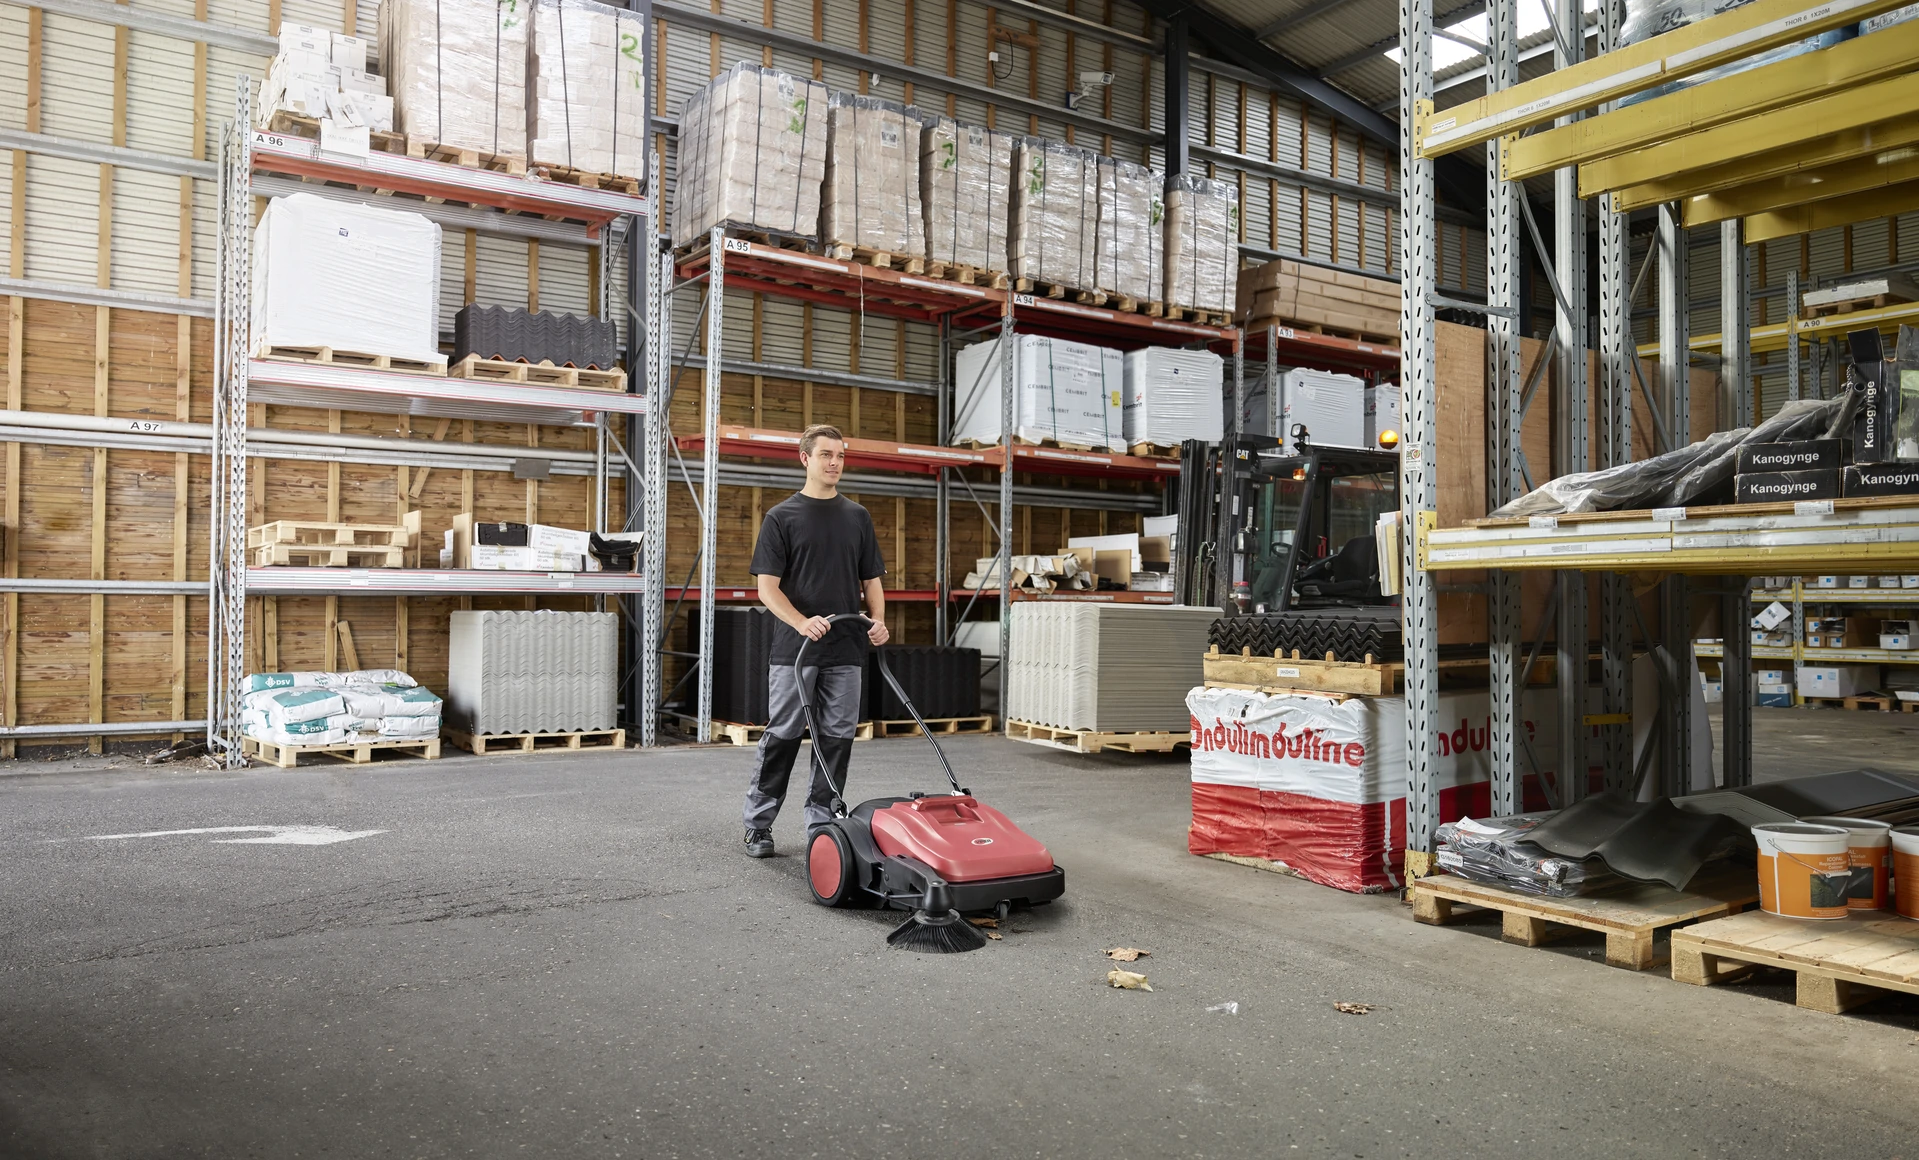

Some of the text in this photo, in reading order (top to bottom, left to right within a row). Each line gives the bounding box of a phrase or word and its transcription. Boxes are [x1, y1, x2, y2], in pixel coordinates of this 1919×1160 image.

[1785, 17, 1802, 26] THOR
[1811, 7, 1831, 18] 1X20M
[621, 33, 642, 63] 2
[256, 134, 283, 146] A 96
[727, 240, 748, 251] A 95
[1016, 295, 1033, 304] A 94
[1811, 319, 1820, 327] 90
[1280, 328, 1284, 336] A
[1066, 347, 1088, 355] CEMBRIT
[1065, 389, 1088, 397] CEMBRIT
[1864, 381, 1877, 448] Kanogynge
[130, 421, 159, 431] A 97
[1236, 449, 1249, 460] CAT
[1752, 452, 1820, 465] Kanogynge
[1861, 473, 1919, 485] Kanogyn
[1750, 482, 1817, 494] Kanogynge
